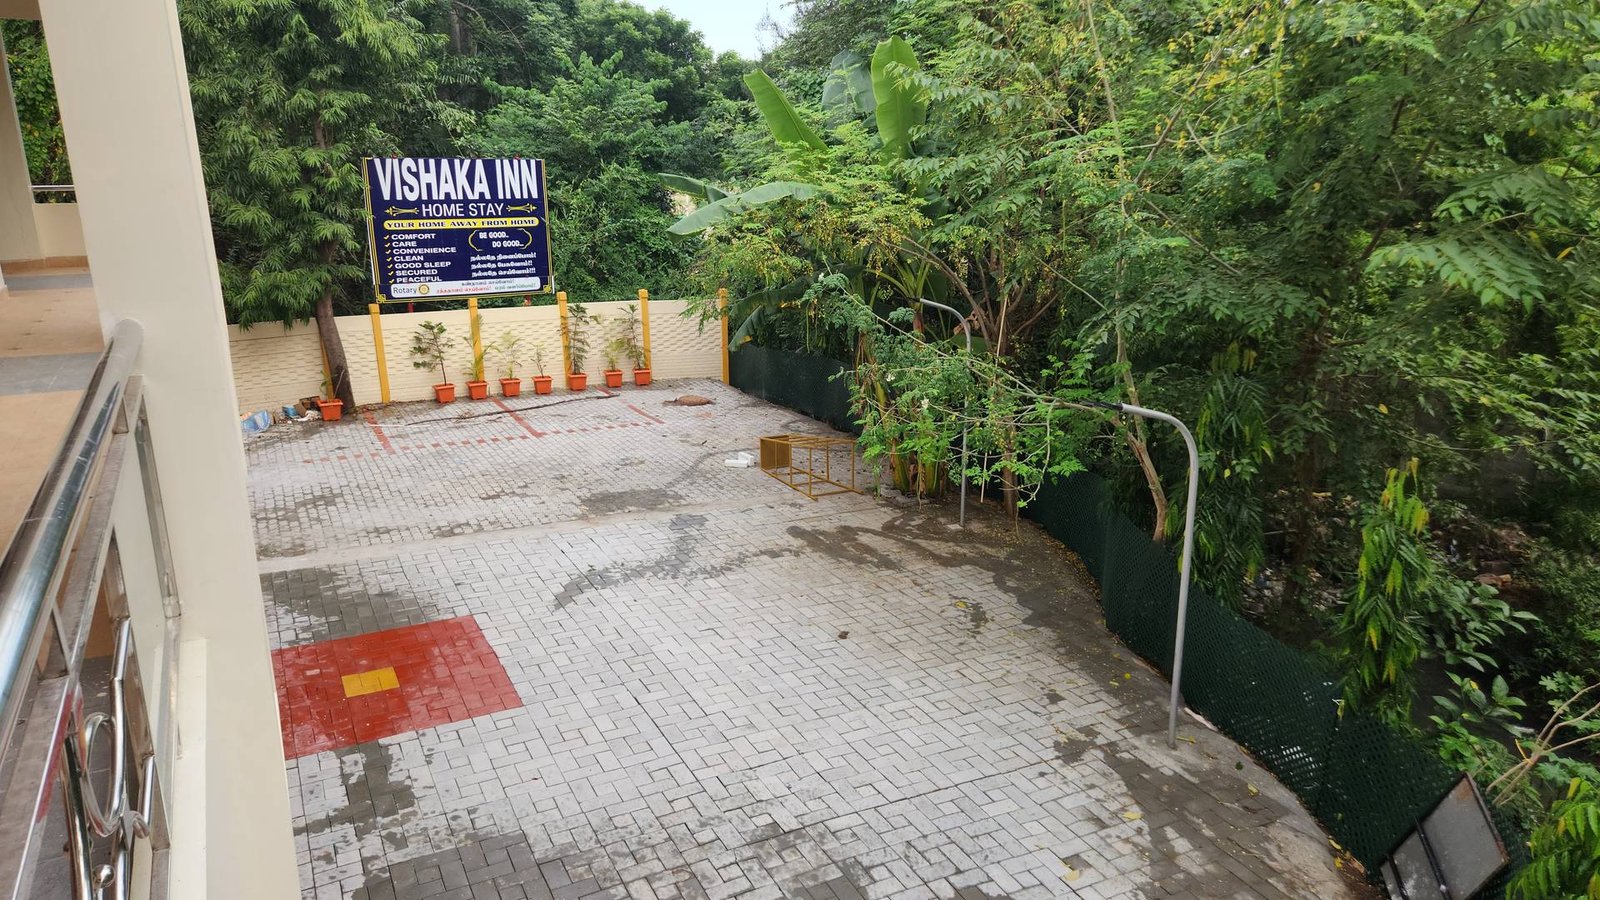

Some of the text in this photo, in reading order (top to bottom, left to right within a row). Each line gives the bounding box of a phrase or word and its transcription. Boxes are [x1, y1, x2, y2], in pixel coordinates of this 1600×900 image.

[374, 158, 538, 201] VISHAKA INN
[422, 203, 504, 216] HOME STAY
[393, 286, 417, 294] Rotary
